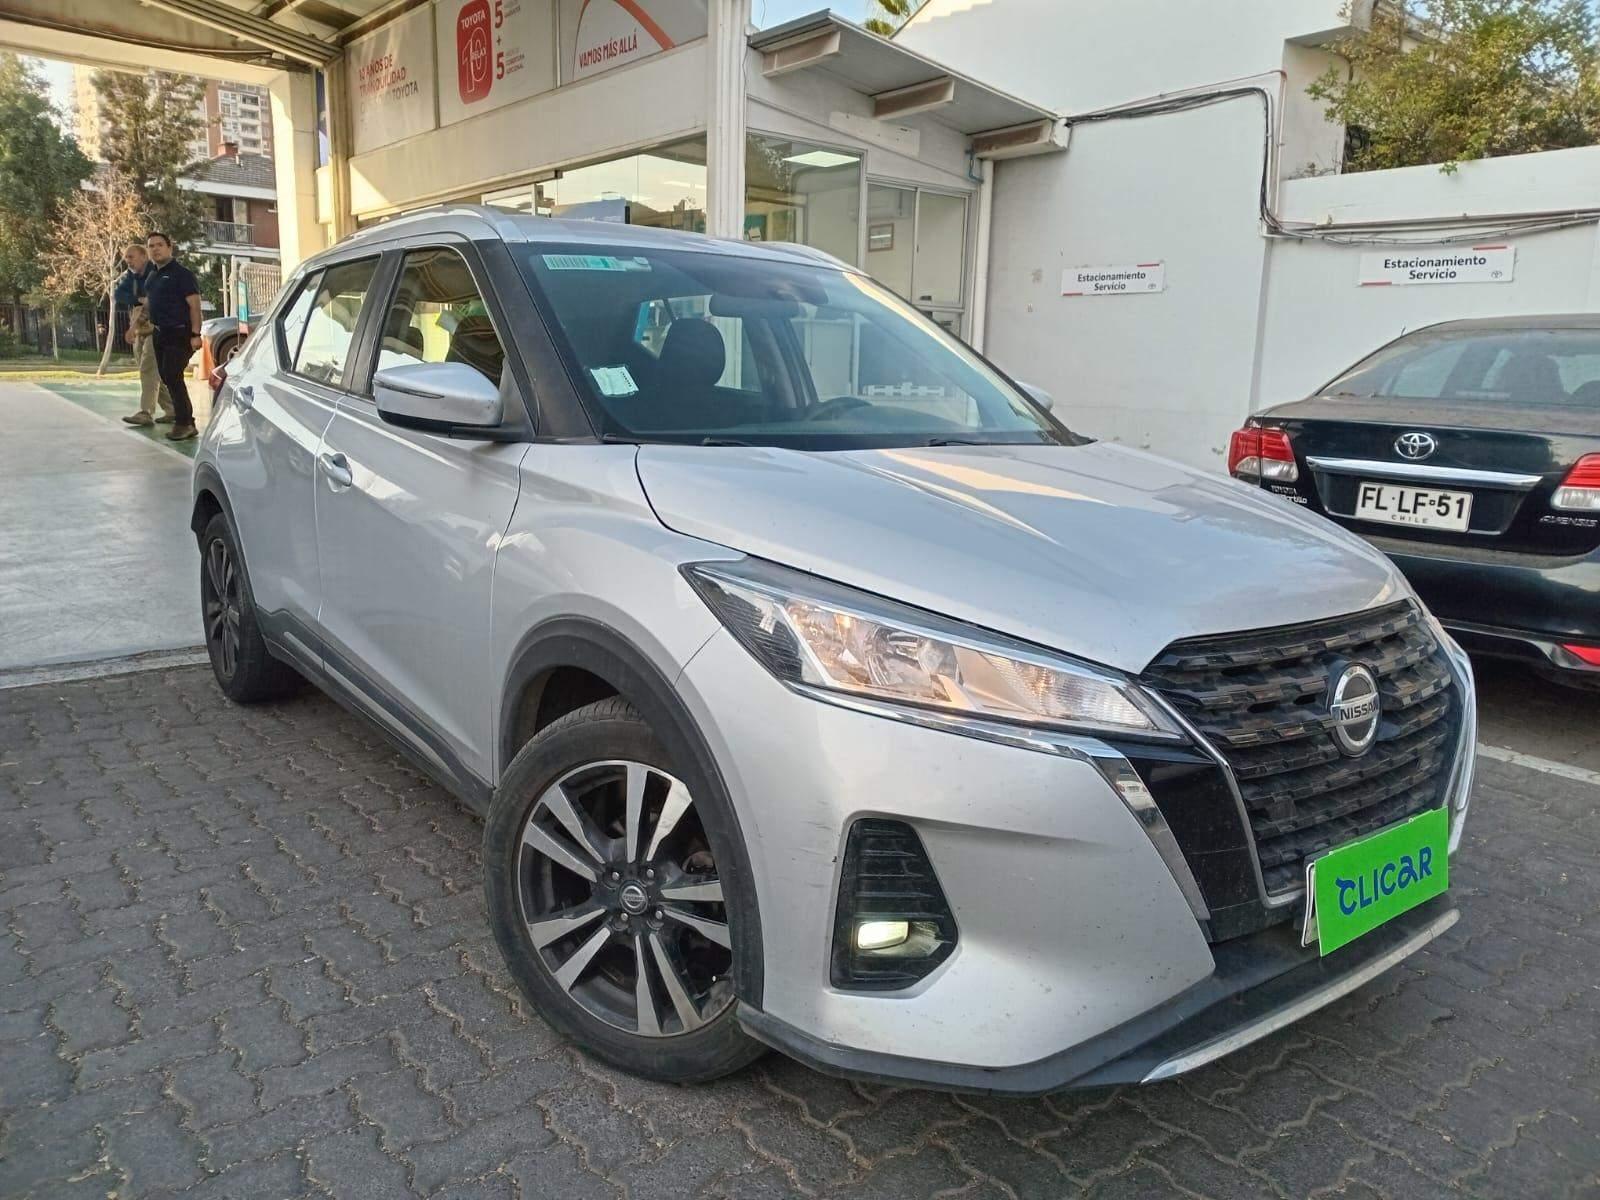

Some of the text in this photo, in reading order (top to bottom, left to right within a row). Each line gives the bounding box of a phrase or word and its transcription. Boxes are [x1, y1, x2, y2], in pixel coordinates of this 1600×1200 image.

[461, 10, 486, 29] TOYOTA
[495, 1, 503, 28] 5
[579, 28, 637, 69] VAMOS MÁS ALLÁ
[384, 54, 393, 69] DE
[462, 27, 487, 93] 10
[496, 52, 504, 79] 5
[392, 81, 418, 100] TOYOTA
[1385, 256, 1487, 269] Estacionamiento
[1077, 271, 1146, 283] Estacionamiento
[1409, 270, 1457, 280] Servicio
[1094, 282, 1126, 291] Servicio
[1391, 514, 1428, 524] CHILE
[1340, 700, 1377, 721] NISSAN
